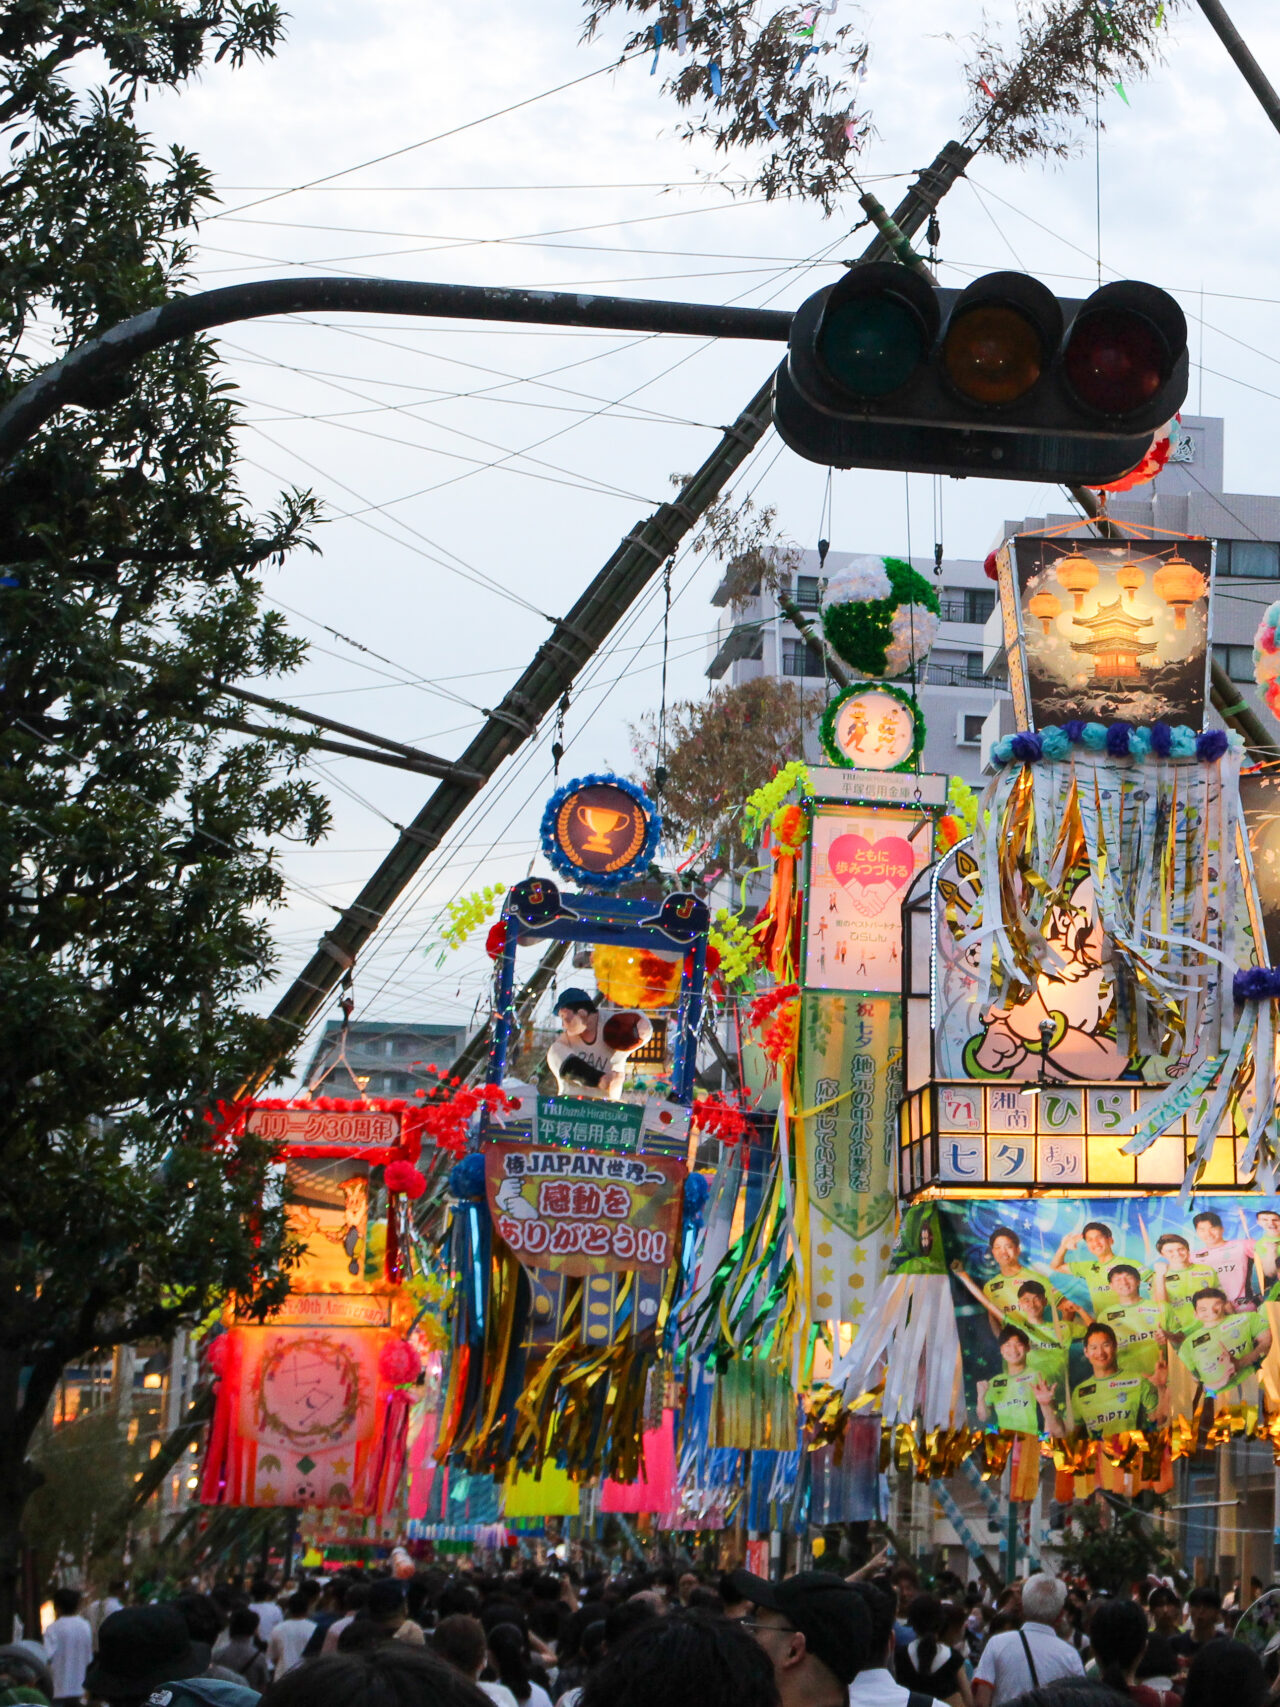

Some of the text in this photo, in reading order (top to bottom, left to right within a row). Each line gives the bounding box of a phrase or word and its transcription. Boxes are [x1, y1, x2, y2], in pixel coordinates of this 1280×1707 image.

[842, 782, 910, 798] 平塚信用金庫
[855, 849, 889, 862] ともに
[836, 862, 908, 877] 歩みつづける
[849, 1002, 876, 1193] 祝 七夕 地元の中小企業を
[540, 1119, 637, 1146] 平塚信用金庫
[504, 1153, 666, 1185] 侍JAPAN世界一
[540, 1179, 631, 1218] 感動を
[500, 1216, 667, 1264] ありがとう!!
[298, 1299, 321, 1314] 30th
